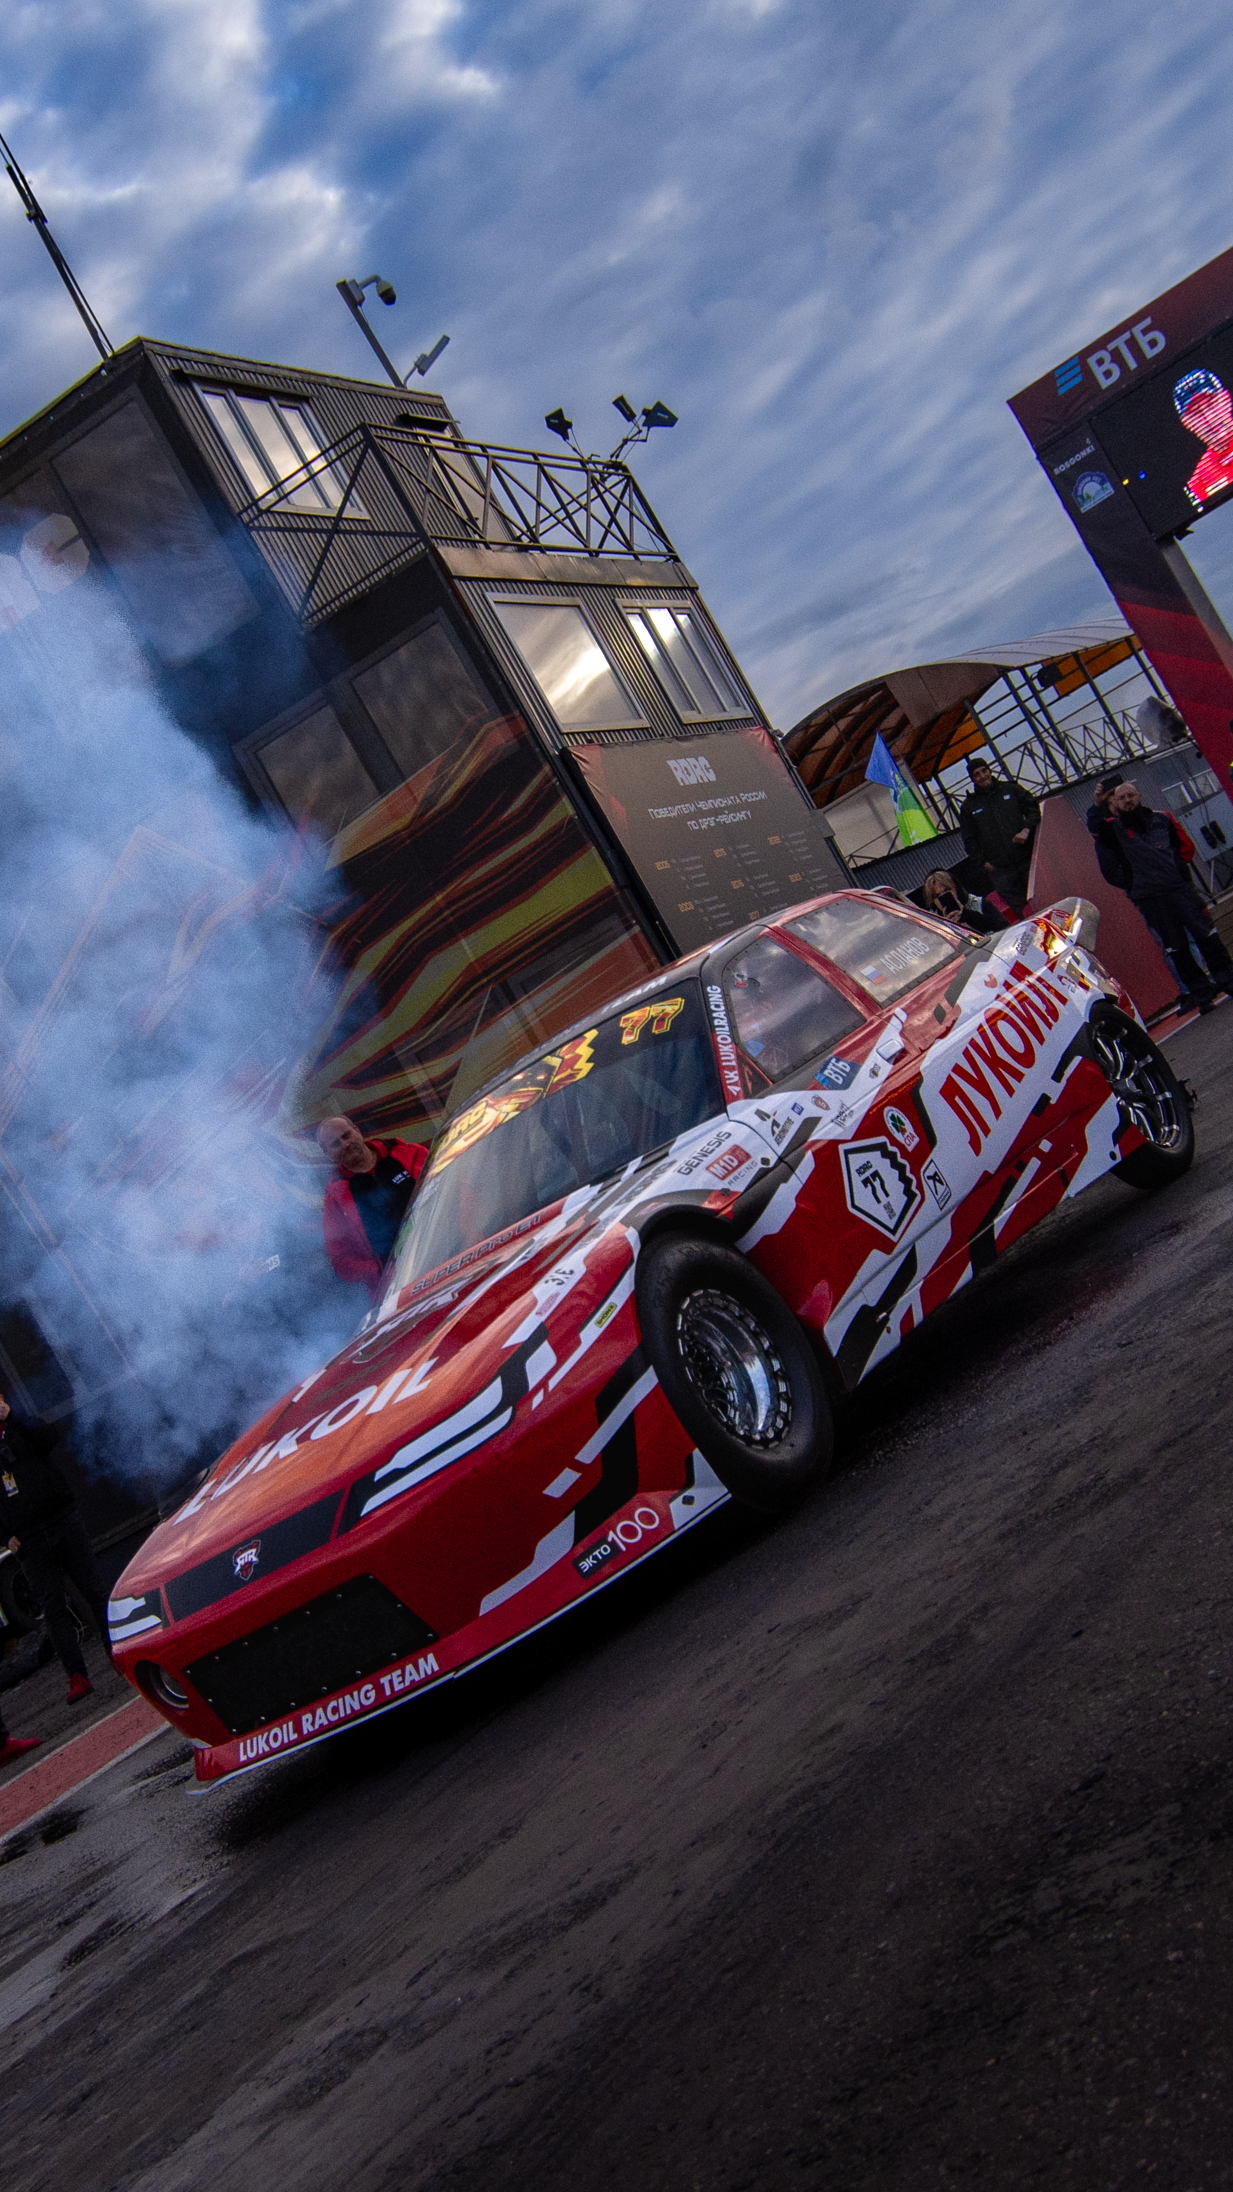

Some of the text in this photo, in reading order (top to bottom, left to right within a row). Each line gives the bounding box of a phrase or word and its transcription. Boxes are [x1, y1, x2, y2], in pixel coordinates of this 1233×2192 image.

[1086, 316, 1167, 390] ВТБ
[879, 936, 930, 975] АСЛАНОВ
[619, 996, 686, 1046] 77
[706, 984, 737, 1066] LUKOILRACING
[825, 1057, 852, 1085] ВТБ
[938, 960, 1069, 1158] ЛУКОЙЛ
[677, 1130, 732, 1176] GENESIS
[727, 1160, 759, 1187] RACING
[861, 1169, 890, 1205] 77
[411, 1251, 474, 1296] SUPER
[515, 1211, 546, 1235] ET
[172, 1356, 440, 1527] LUKOIL
[578, 1507, 660, 1574] ЭКТО 100
[239, 1652, 440, 1763] LUKOIL RACING TEAM
